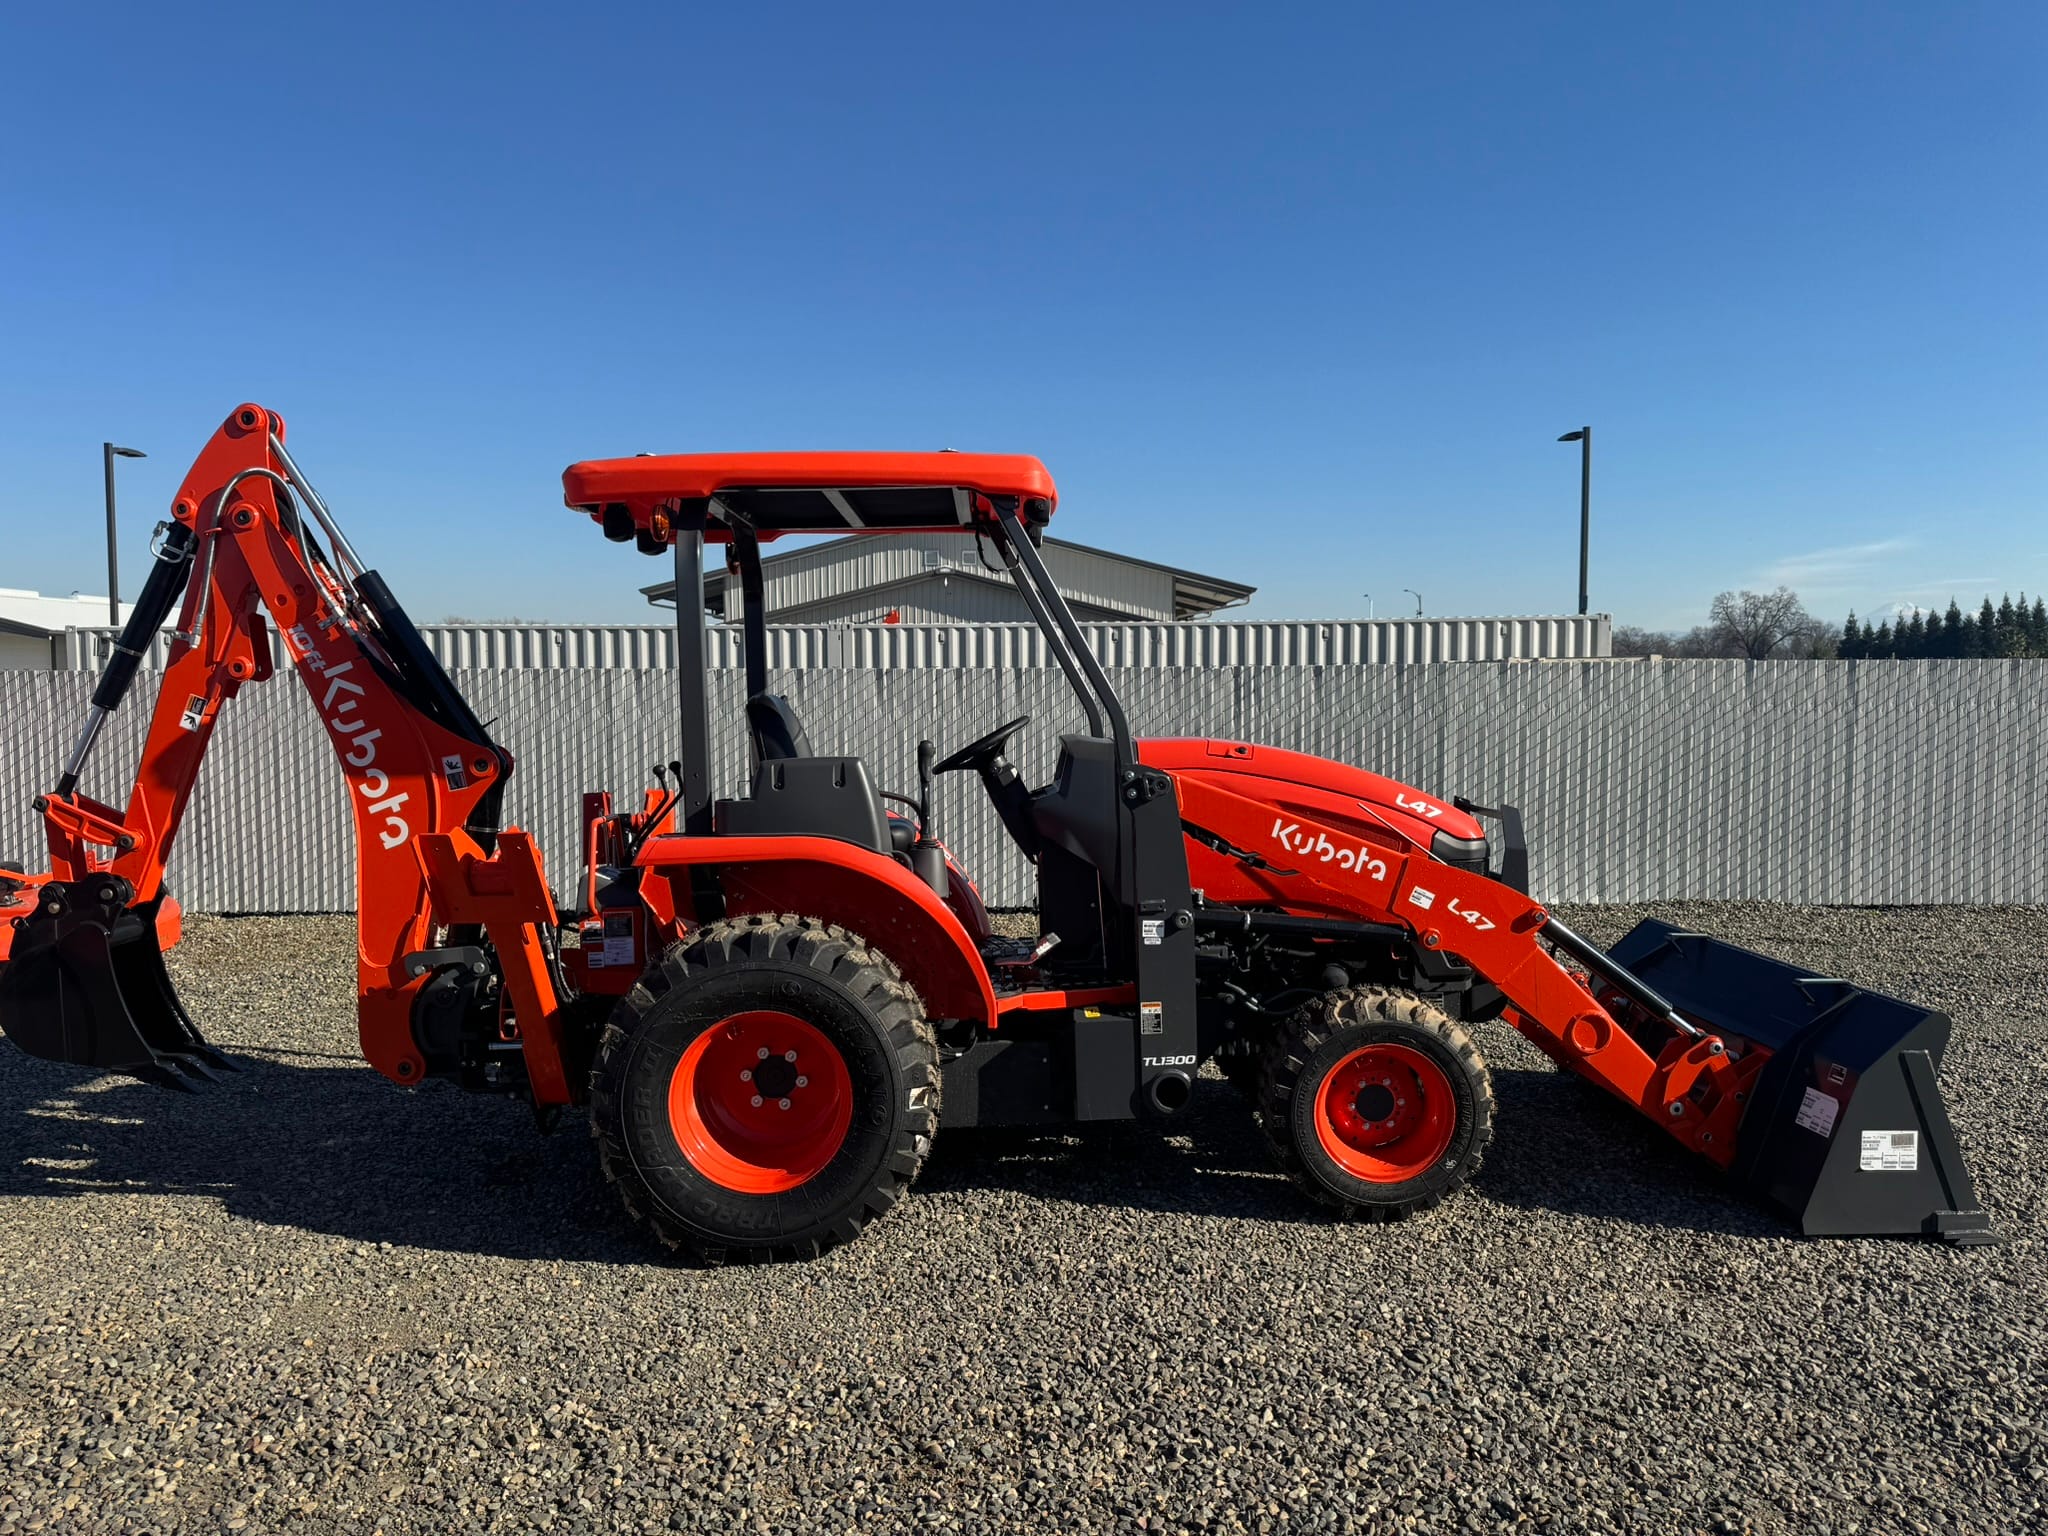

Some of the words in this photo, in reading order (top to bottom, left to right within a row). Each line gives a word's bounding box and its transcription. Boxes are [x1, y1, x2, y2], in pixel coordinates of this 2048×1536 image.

[323, 661, 409, 850] Kubota
[1395, 793, 1442, 818] L47
[1271, 818, 1386, 881] Kubota
[1447, 898, 1496, 931] L47
[1143, 1055, 1197, 1067] TL1300
